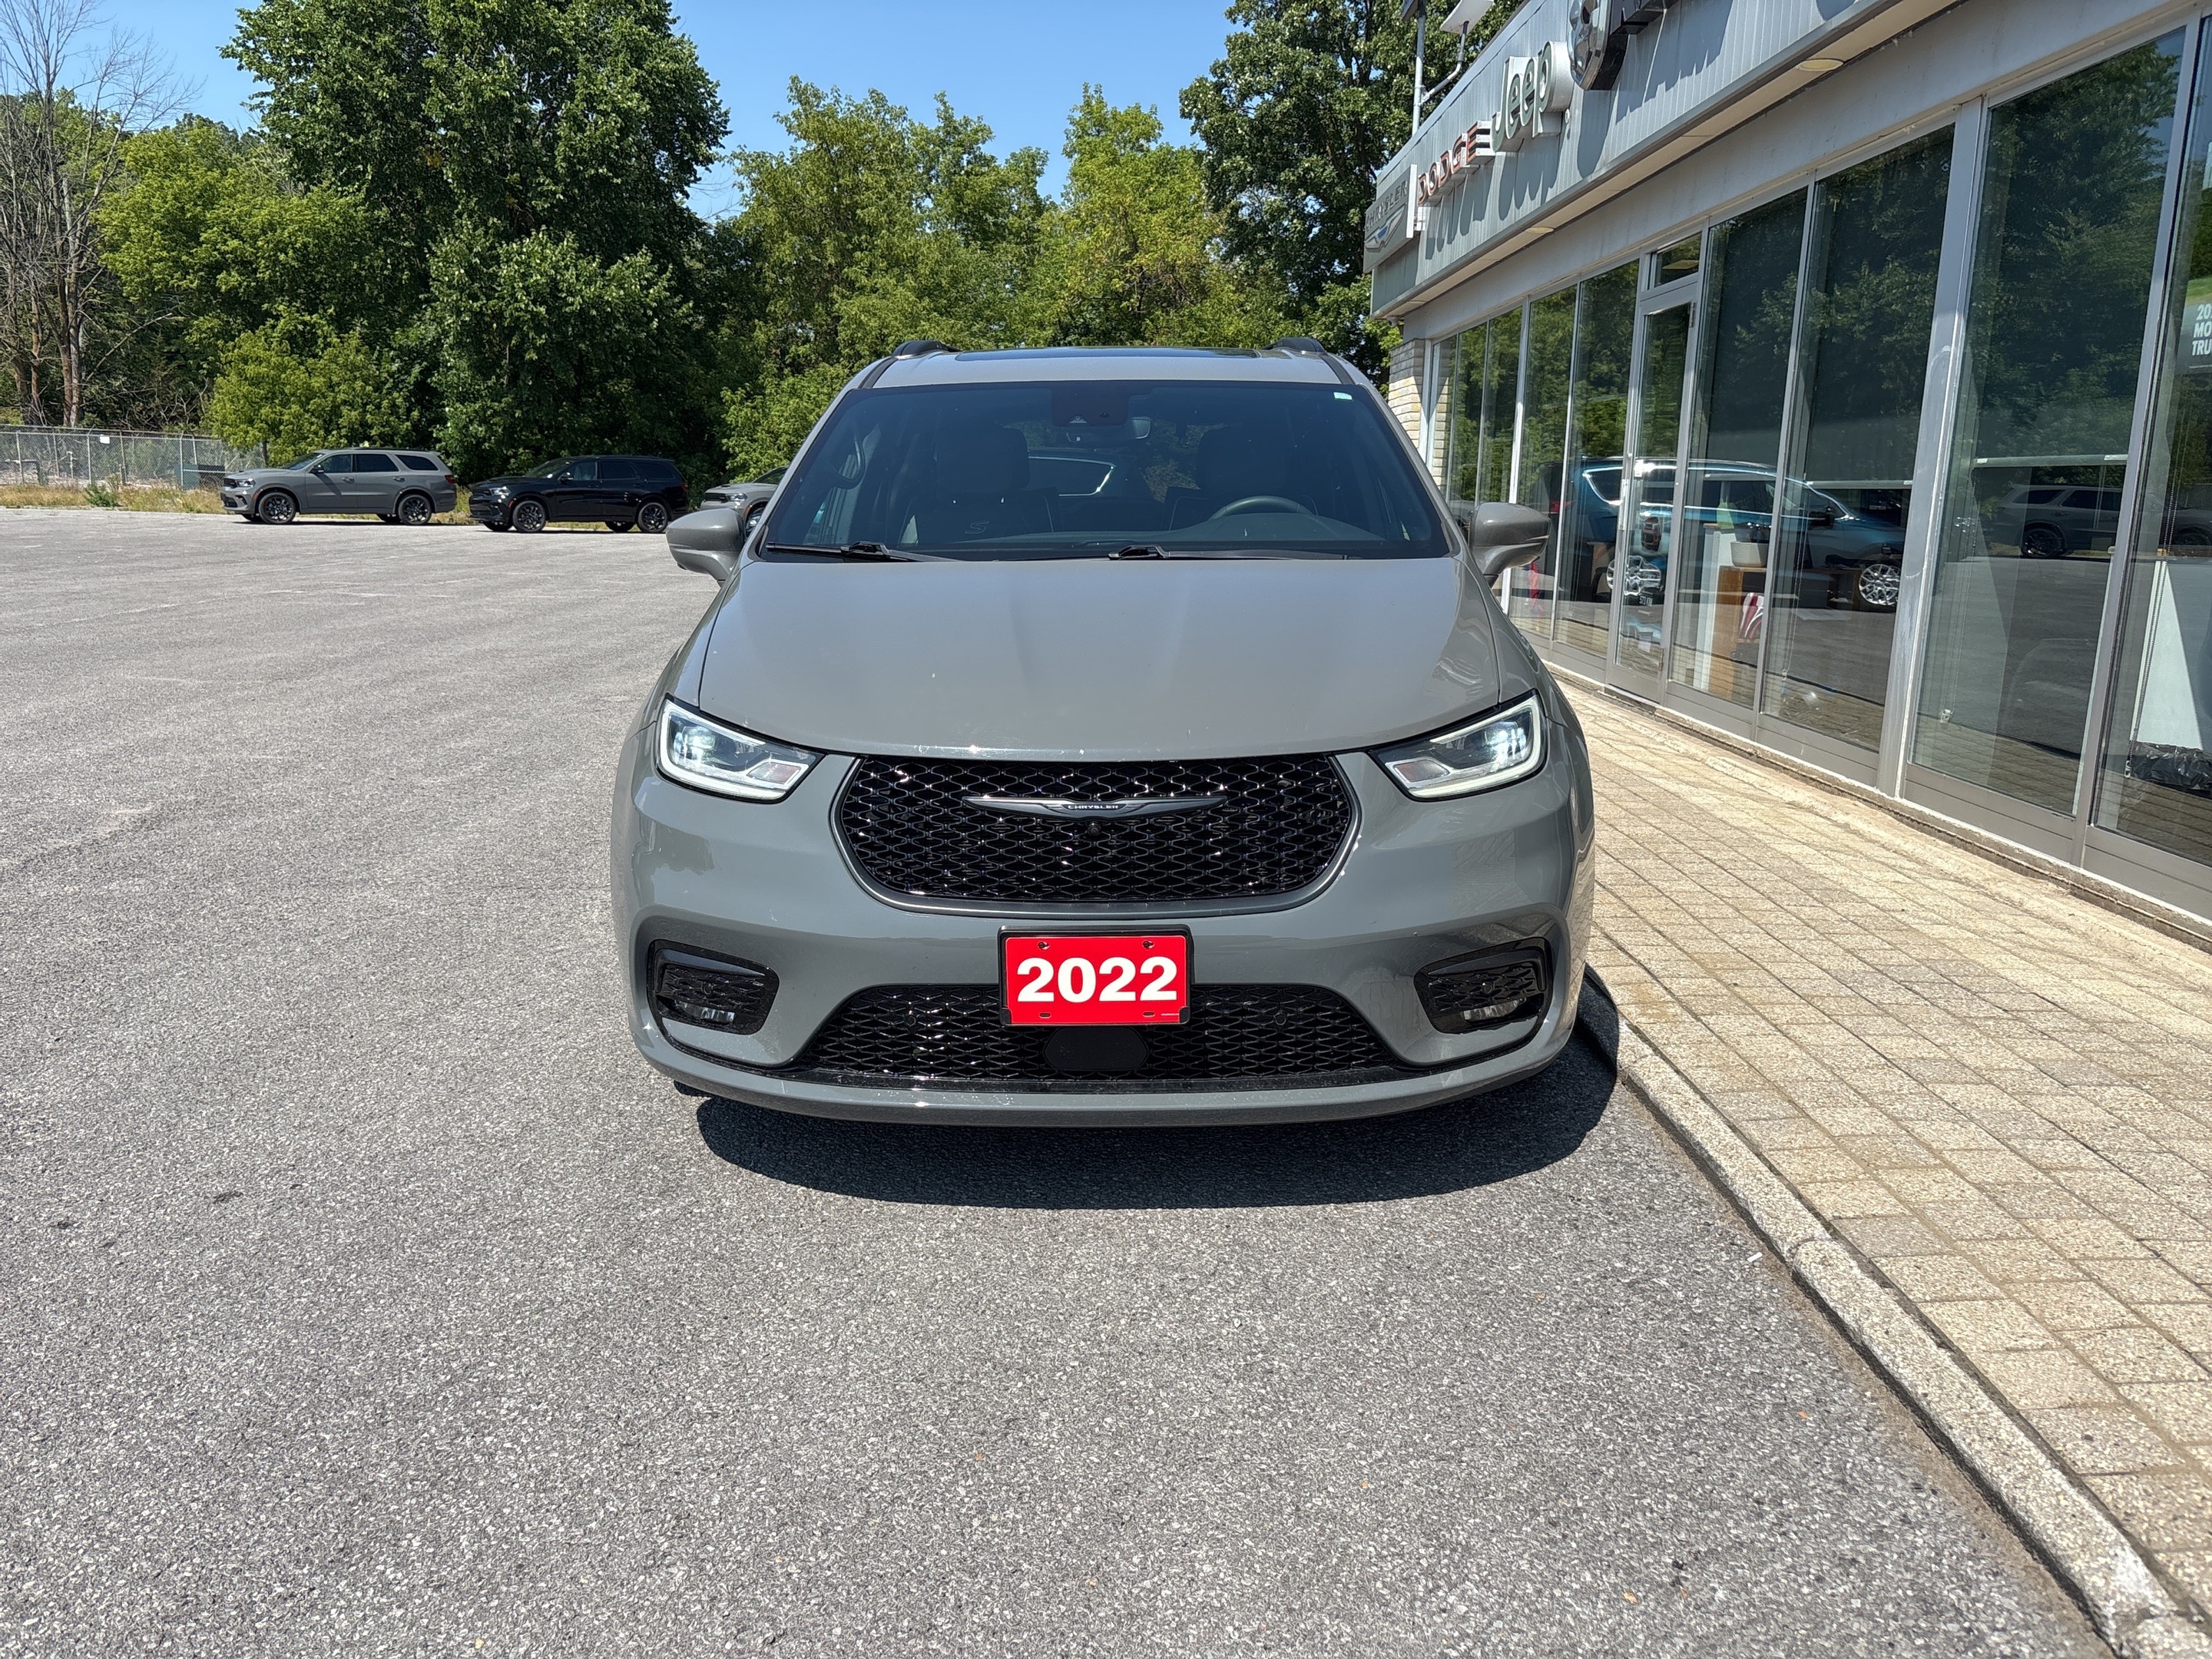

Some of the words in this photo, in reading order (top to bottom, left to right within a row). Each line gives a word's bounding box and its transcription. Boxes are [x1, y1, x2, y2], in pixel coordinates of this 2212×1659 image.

[1491, 41, 1551, 152] Jeep
[1417, 121, 1479, 207] DODGE
[2197, 303, 2212, 320] 20
[2194, 321, 2212, 338] MO
[2191, 339, 2212, 356] TRU
[1017, 955, 1177, 1003] 2022
